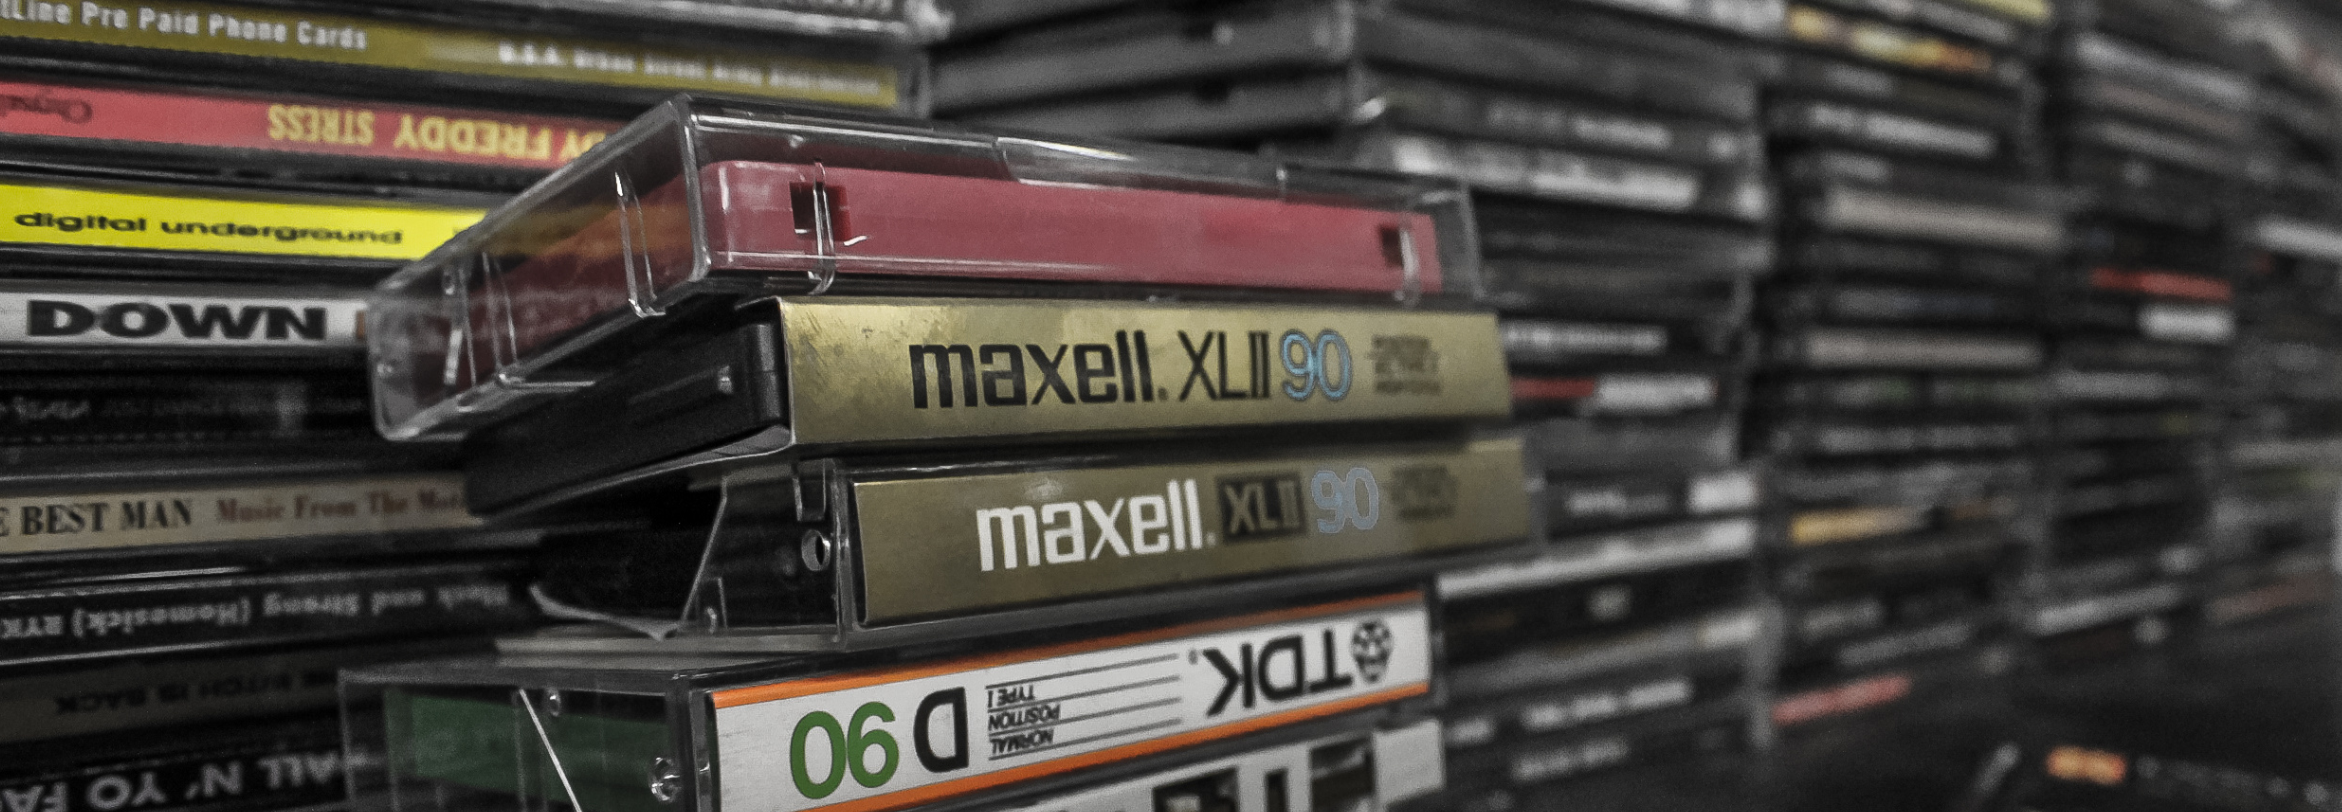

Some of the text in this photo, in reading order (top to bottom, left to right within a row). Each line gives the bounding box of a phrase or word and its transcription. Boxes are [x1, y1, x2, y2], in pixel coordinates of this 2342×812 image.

[138, 7, 200, 35] Paid
[208, 13, 287, 43] Phone
[296, 20, 368, 51] Cards
[268, 104, 374, 146] STRESS
[395, 115, 553, 161] FREDDY
[14, 212, 402, 245] digital underground
[27, 300, 326, 340] DOWN
[909, 330, 1153, 409] maxell
[1281, 329, 1352, 401] 90
[22, 502, 110, 535] BEST
[120, 499, 193, 532] MAN
[216, 496, 284, 523] Music
[294, 493, 357, 520] From
[976, 479, 1202, 572] maxell
[1311, 466, 1379, 534] 90
[1204, 629, 1355, 717] TDK
[56, 687, 147, 715] BACK
[997, 684, 1035, 707] TYPE
[988, 703, 1060, 731] POSITION
[789, 687, 969, 800] D 90
[990, 727, 1054, 754] NORMAL
[0, 781, 69, 812] FA
[86, 771, 166, 811] YO
